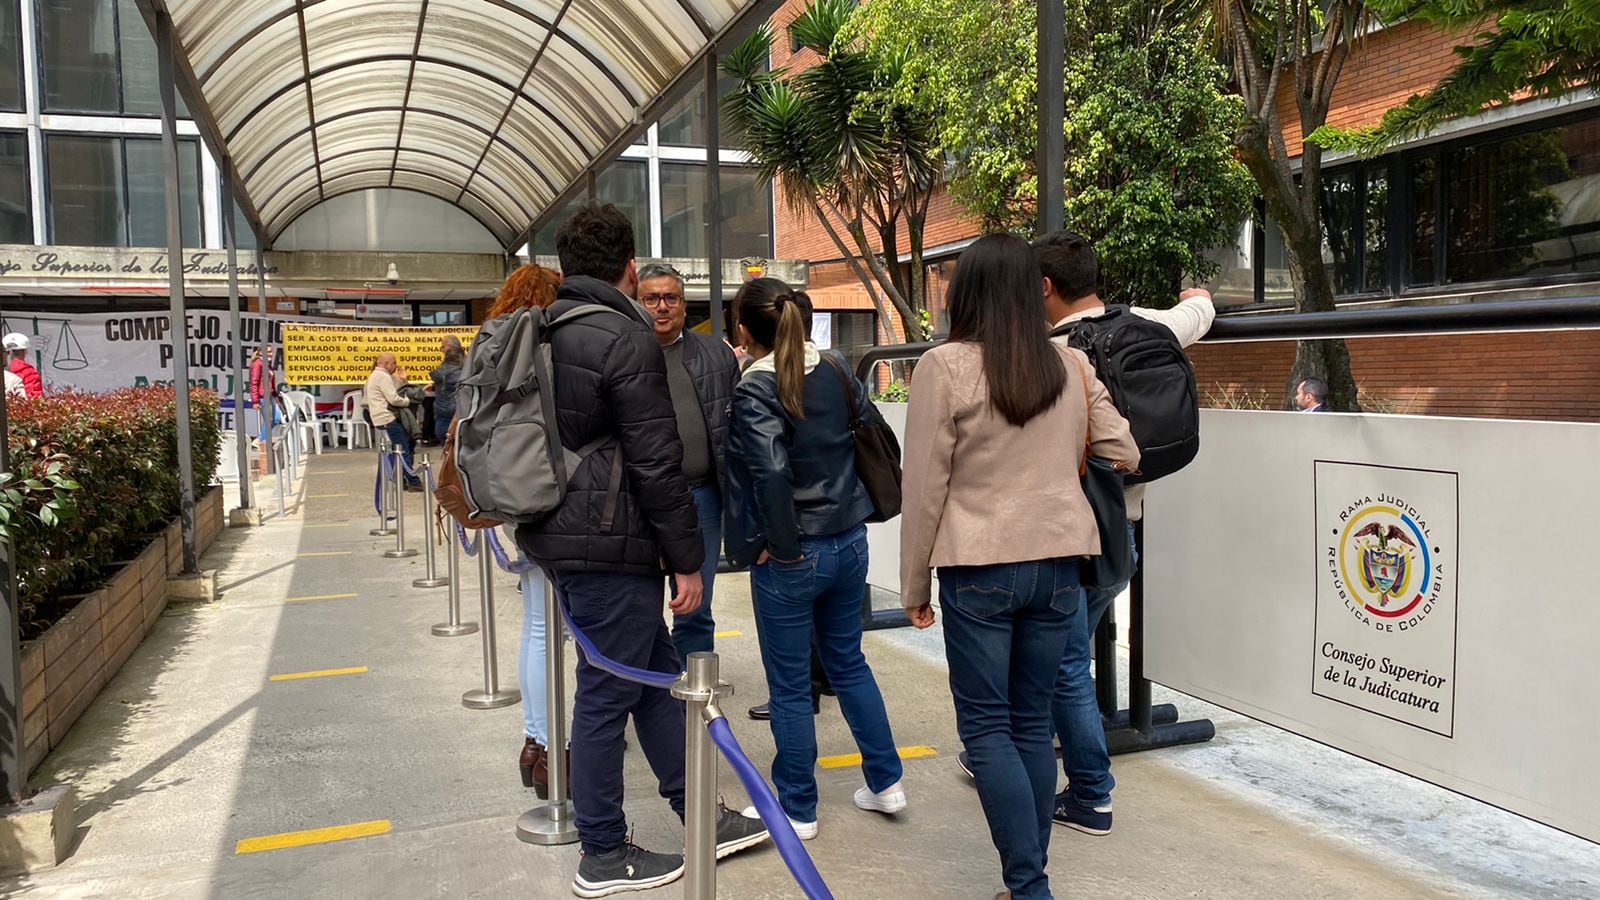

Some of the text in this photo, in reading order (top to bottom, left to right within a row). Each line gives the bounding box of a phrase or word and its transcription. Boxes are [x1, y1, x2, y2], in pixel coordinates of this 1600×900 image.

[32, 253, 112, 275] Superior
[121, 256, 142, 272] de
[150, 255, 169, 274] la
[105, 315, 220, 342] COMPEJO
[1339, 493, 1431, 538] RAMA JUDICIAL
[1328, 546, 1443, 633] REPÚBLICA DE COLOMBIA
[1321, 641, 1447, 689] Consejo Superior
[1323, 665, 1441, 714] de la Judicatura
